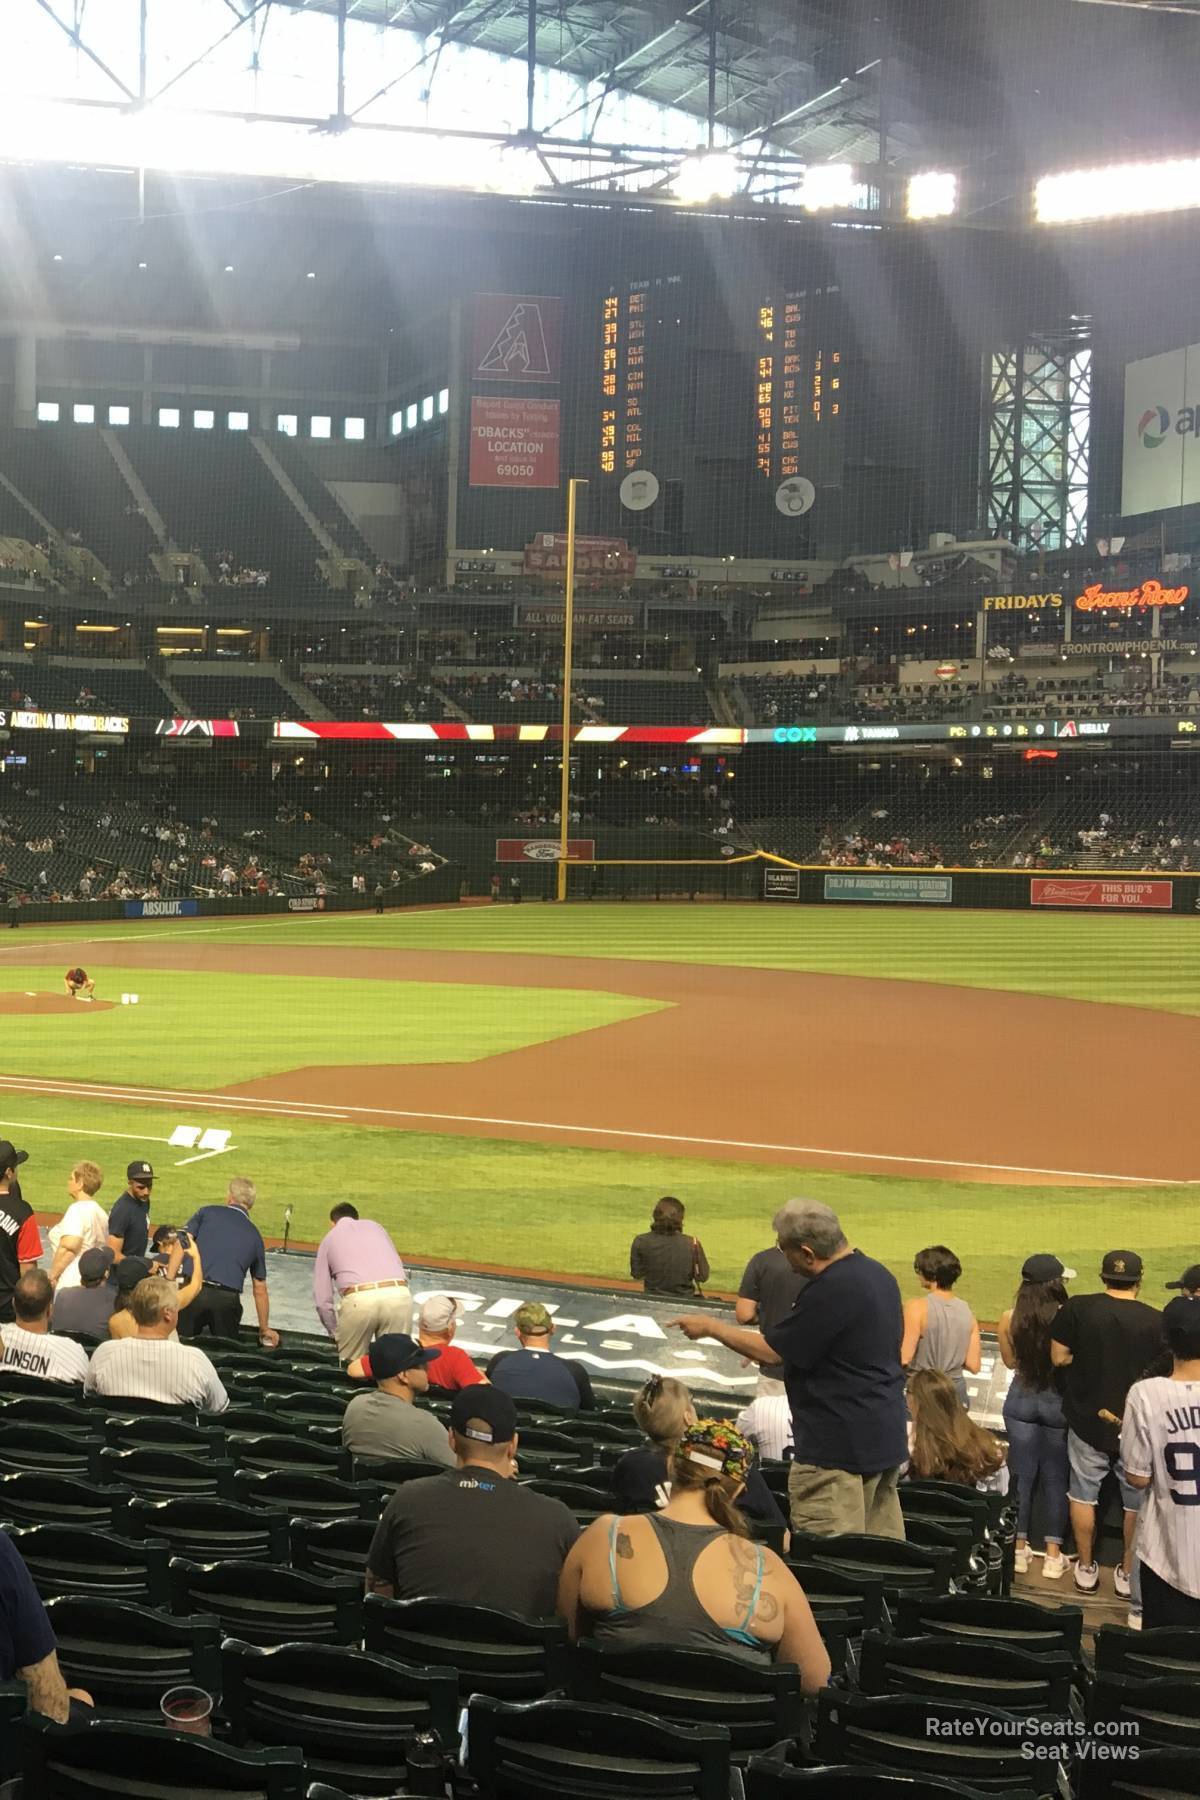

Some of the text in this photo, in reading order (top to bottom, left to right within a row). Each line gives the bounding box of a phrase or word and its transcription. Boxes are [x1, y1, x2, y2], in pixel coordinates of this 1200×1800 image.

[605, 297, 618, 307] 44
[605, 308, 617, 319] 27
[604, 334, 616, 344] 31
[603, 359, 616, 370] 31
[758, 407, 771, 418] 50
[832, 404, 839, 414] 3
[488, 441, 544, 453] LOCATION
[602, 436, 614, 447] 57
[497, 464, 534, 476] 69050
[601, 461, 614, 472] 40
[529, 552, 632, 569] SADLOT
[984, 593, 1062, 610] FRIDAY'S
[525, 613, 634, 625] ALL-YOU-AN-EAT SEATS
[1060, 639, 1198, 655] FRONTROWPHOENIX.com
[11, 711, 53, 729] ARIZONA
[54, 714, 129, 733] DIAMONDBACKS
[1178, 721, 1197, 732] PC:
[950, 726, 967, 736] PC:
[971, 725, 980, 736] 0
[1003, 725, 1012, 735] 0
[1035, 724, 1044, 735] 0
[1079, 723, 1110, 734] KELLY
[774, 727, 816, 743] COX
[1102, 884, 1152, 893] THIS BUD'S
[1101, 894, 1142, 903] FOR YOU.
